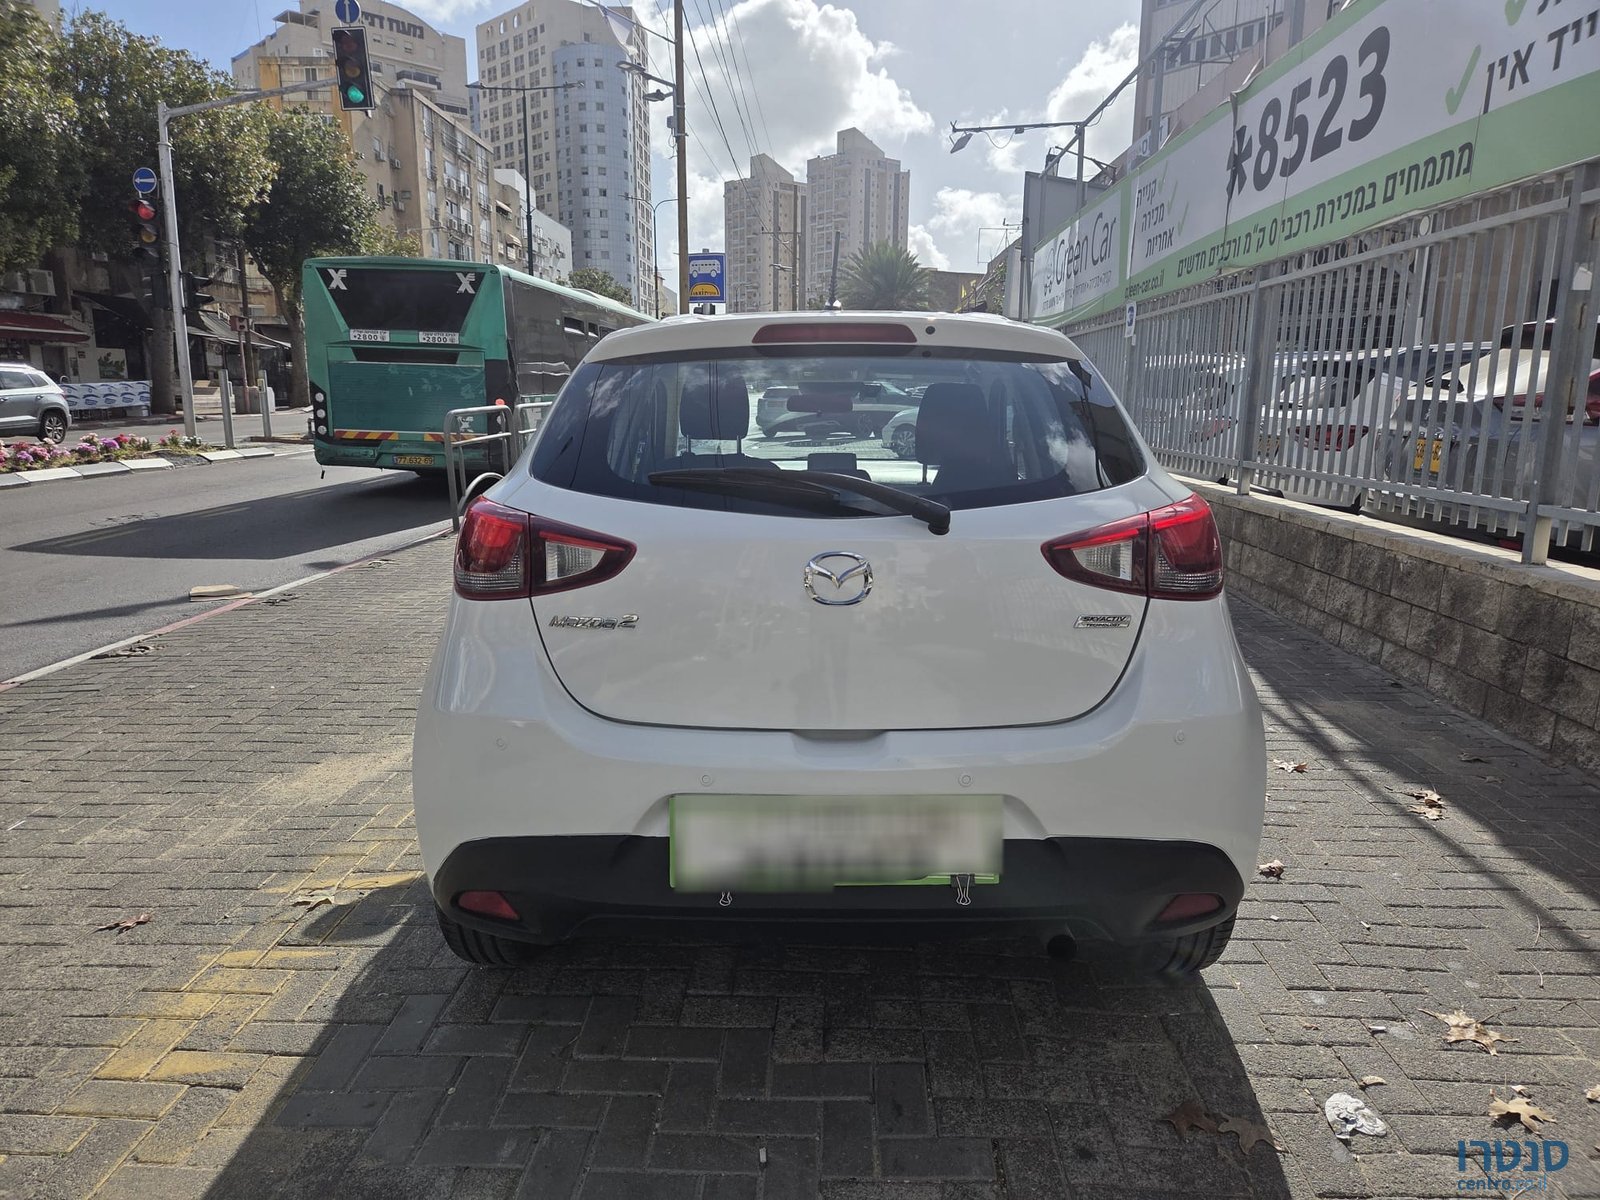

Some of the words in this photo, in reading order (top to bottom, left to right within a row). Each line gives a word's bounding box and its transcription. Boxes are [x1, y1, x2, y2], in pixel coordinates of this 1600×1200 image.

[1483, 41, 1537, 115] אין
[1382, 142, 1474, 204] מתמחים
[1141, 202, 1165, 232] מכירה
[1313, 182, 1377, 231] במכירת
[1268, 217, 1278, 246] 0
[1281, 209, 1311, 241] רכבי
[1055, 239, 1089, 285] Green
[1091, 212, 1117, 266] Car
[1145, 227, 1175, 258] אחריות
[1177, 249, 1207, 277] חדשים
